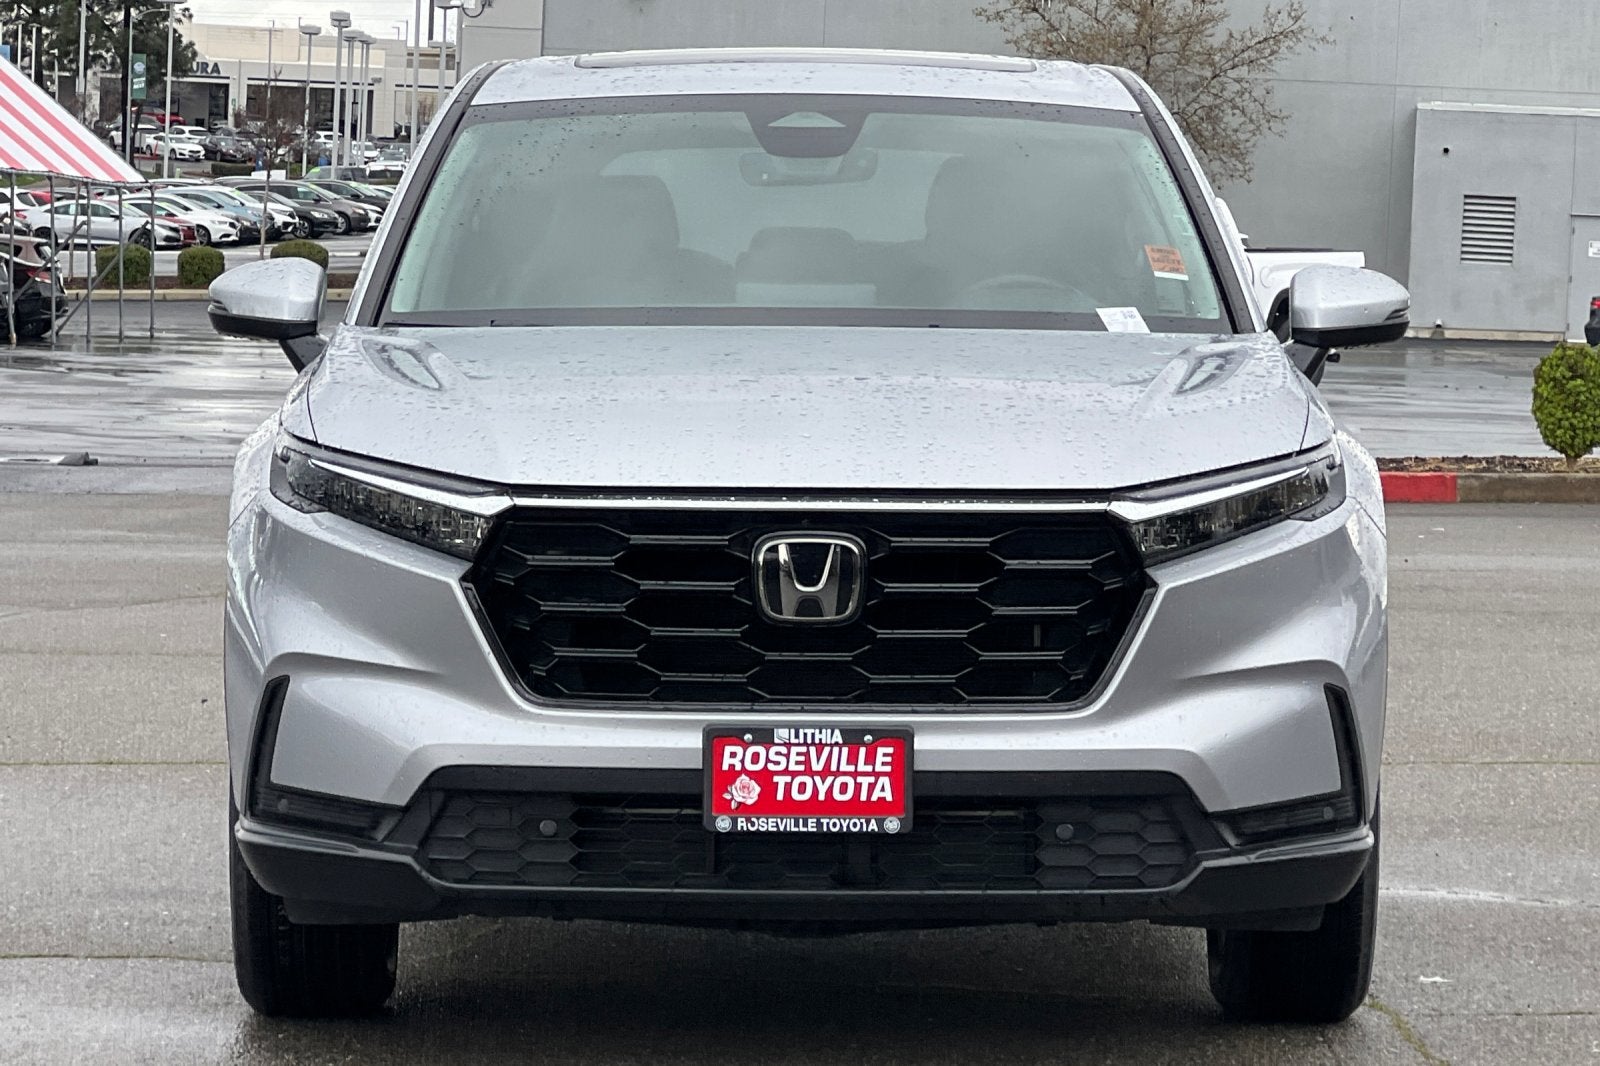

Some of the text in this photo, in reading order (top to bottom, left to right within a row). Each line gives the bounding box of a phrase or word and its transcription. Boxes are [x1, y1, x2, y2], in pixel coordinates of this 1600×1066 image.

[190, 61, 221, 75] URA
[789, 728, 843, 744] LITHIA
[721, 745, 895, 772] ROSEVILLE
[772, 775, 894, 802] TOYOTA
[820, 818, 878, 833] TOYOTA
